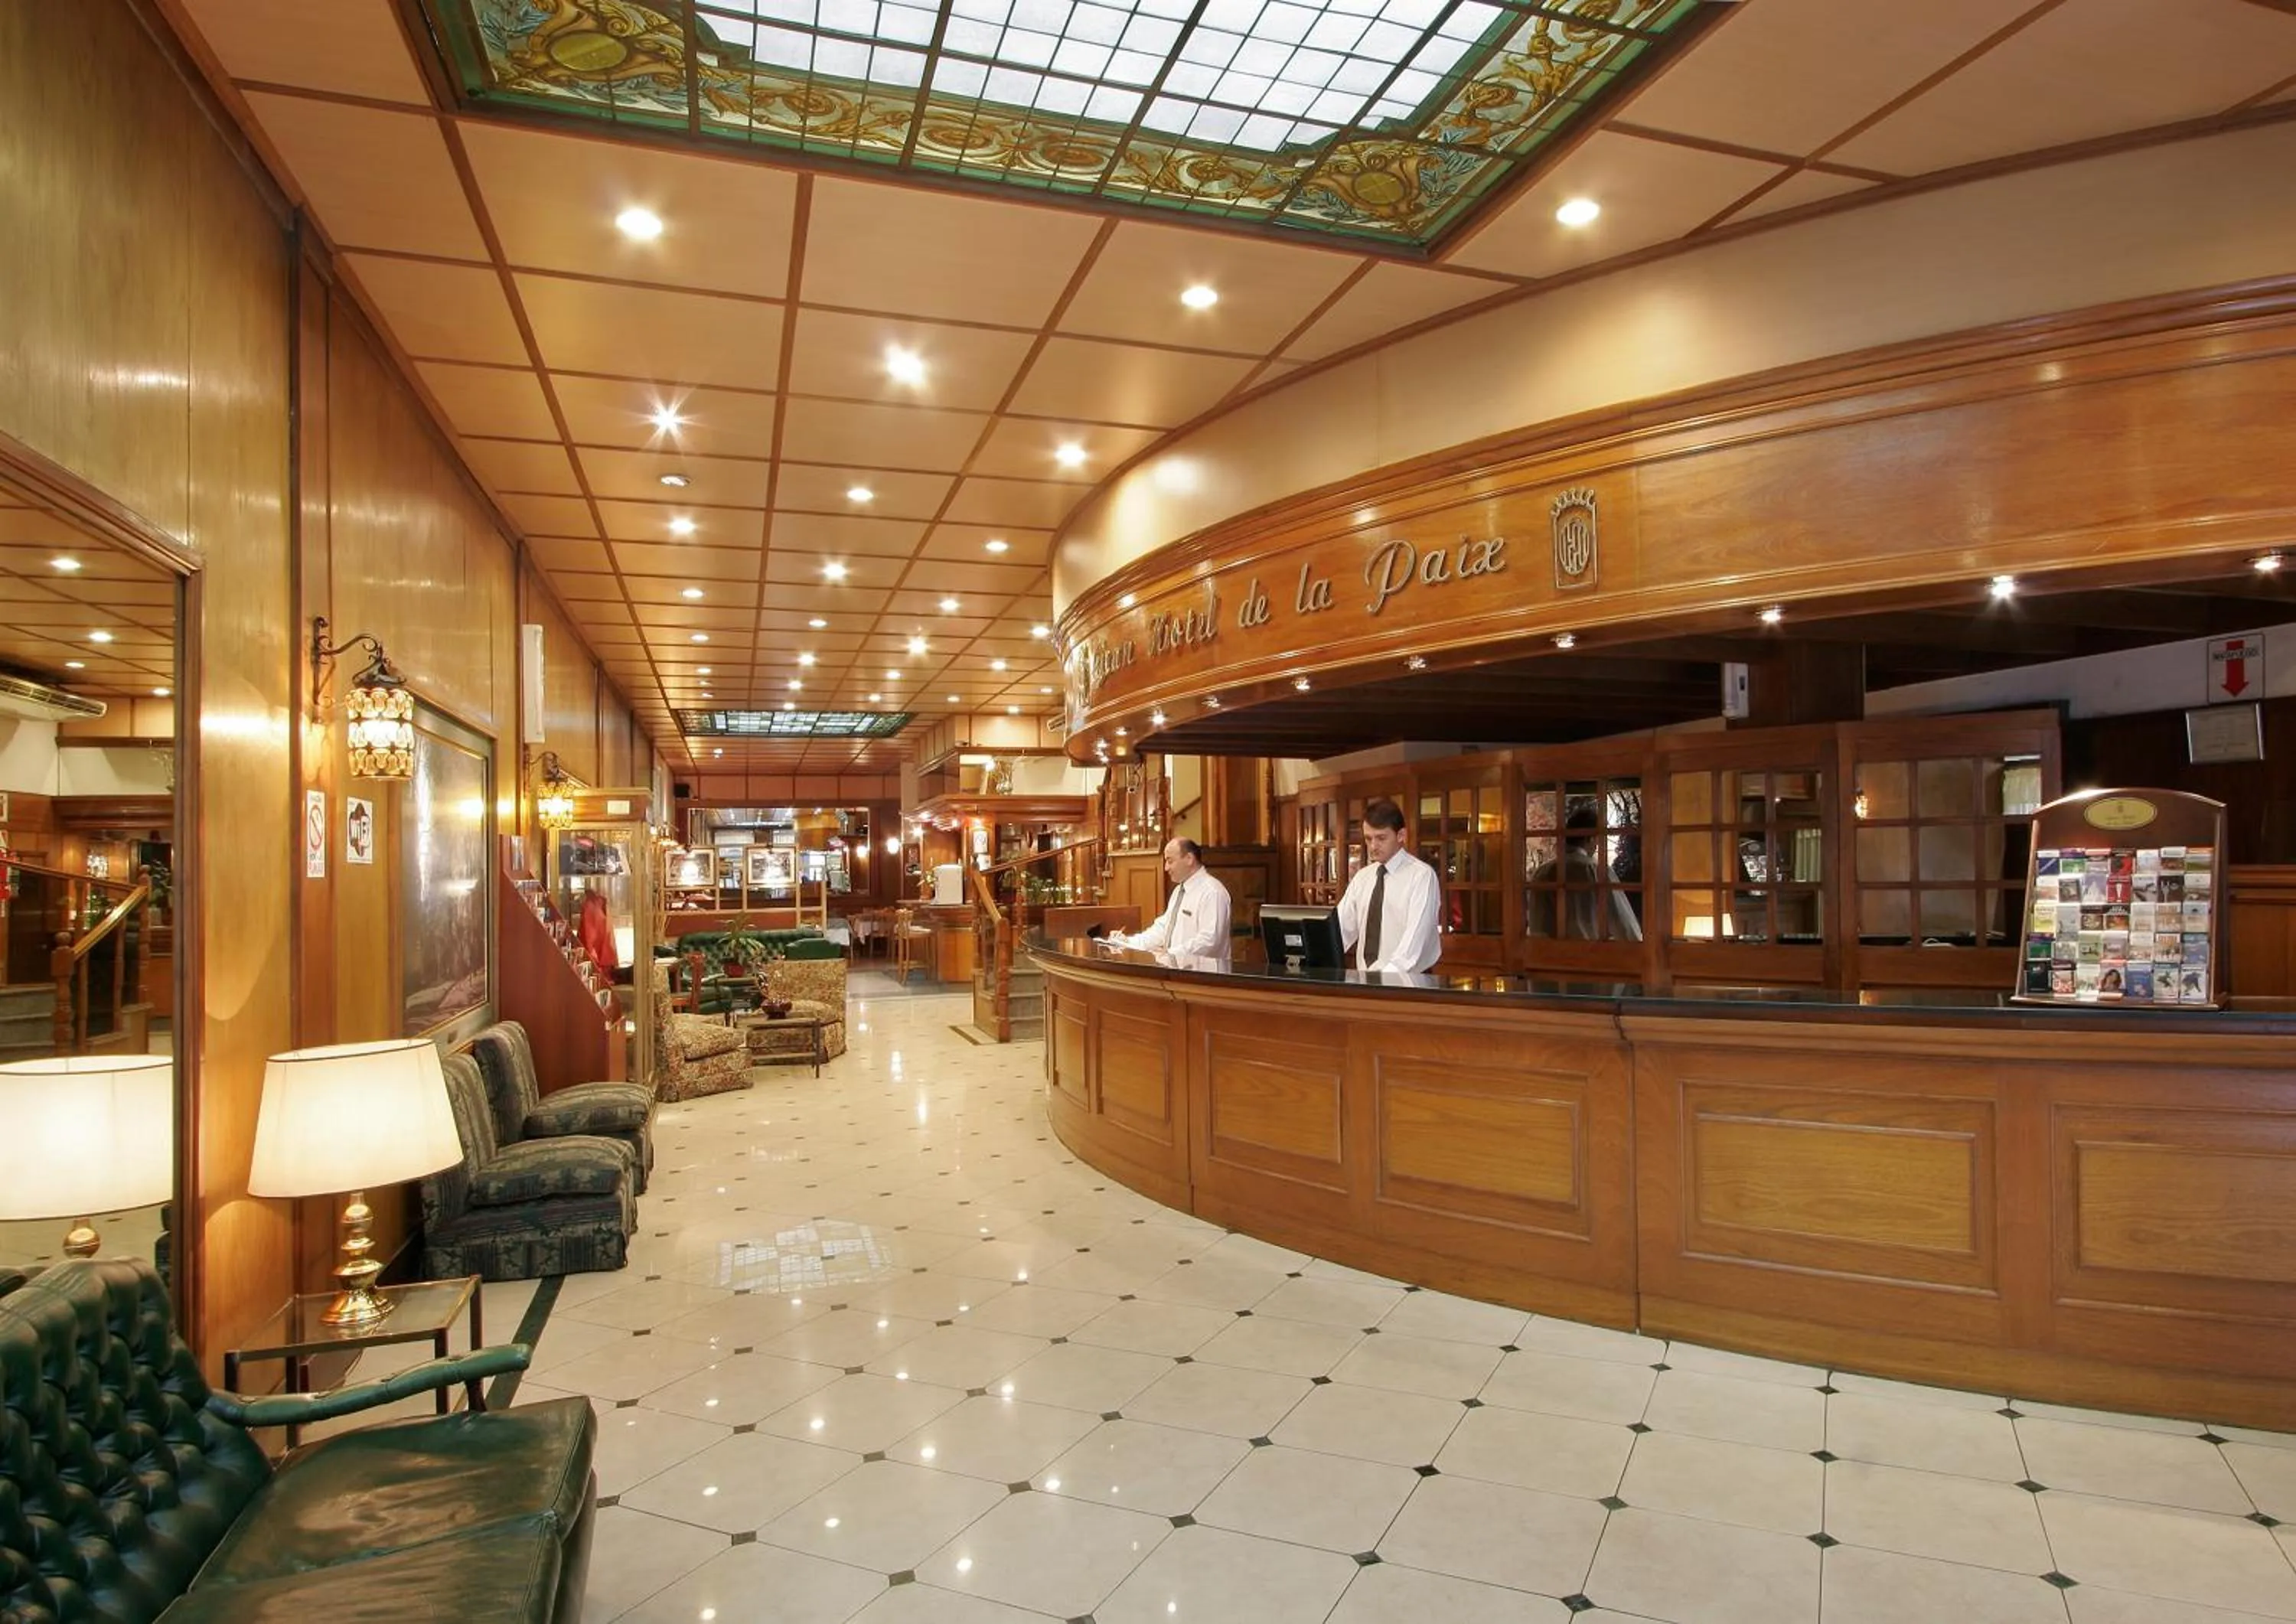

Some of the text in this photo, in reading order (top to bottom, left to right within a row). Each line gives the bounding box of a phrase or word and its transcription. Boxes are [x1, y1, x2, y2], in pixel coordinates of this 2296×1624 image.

[1150, 591, 1218, 658] Hotel
[1238, 577, 1270, 628] de
[1296, 563, 1335, 613] la
[1365, 536, 1506, 615] Paix
